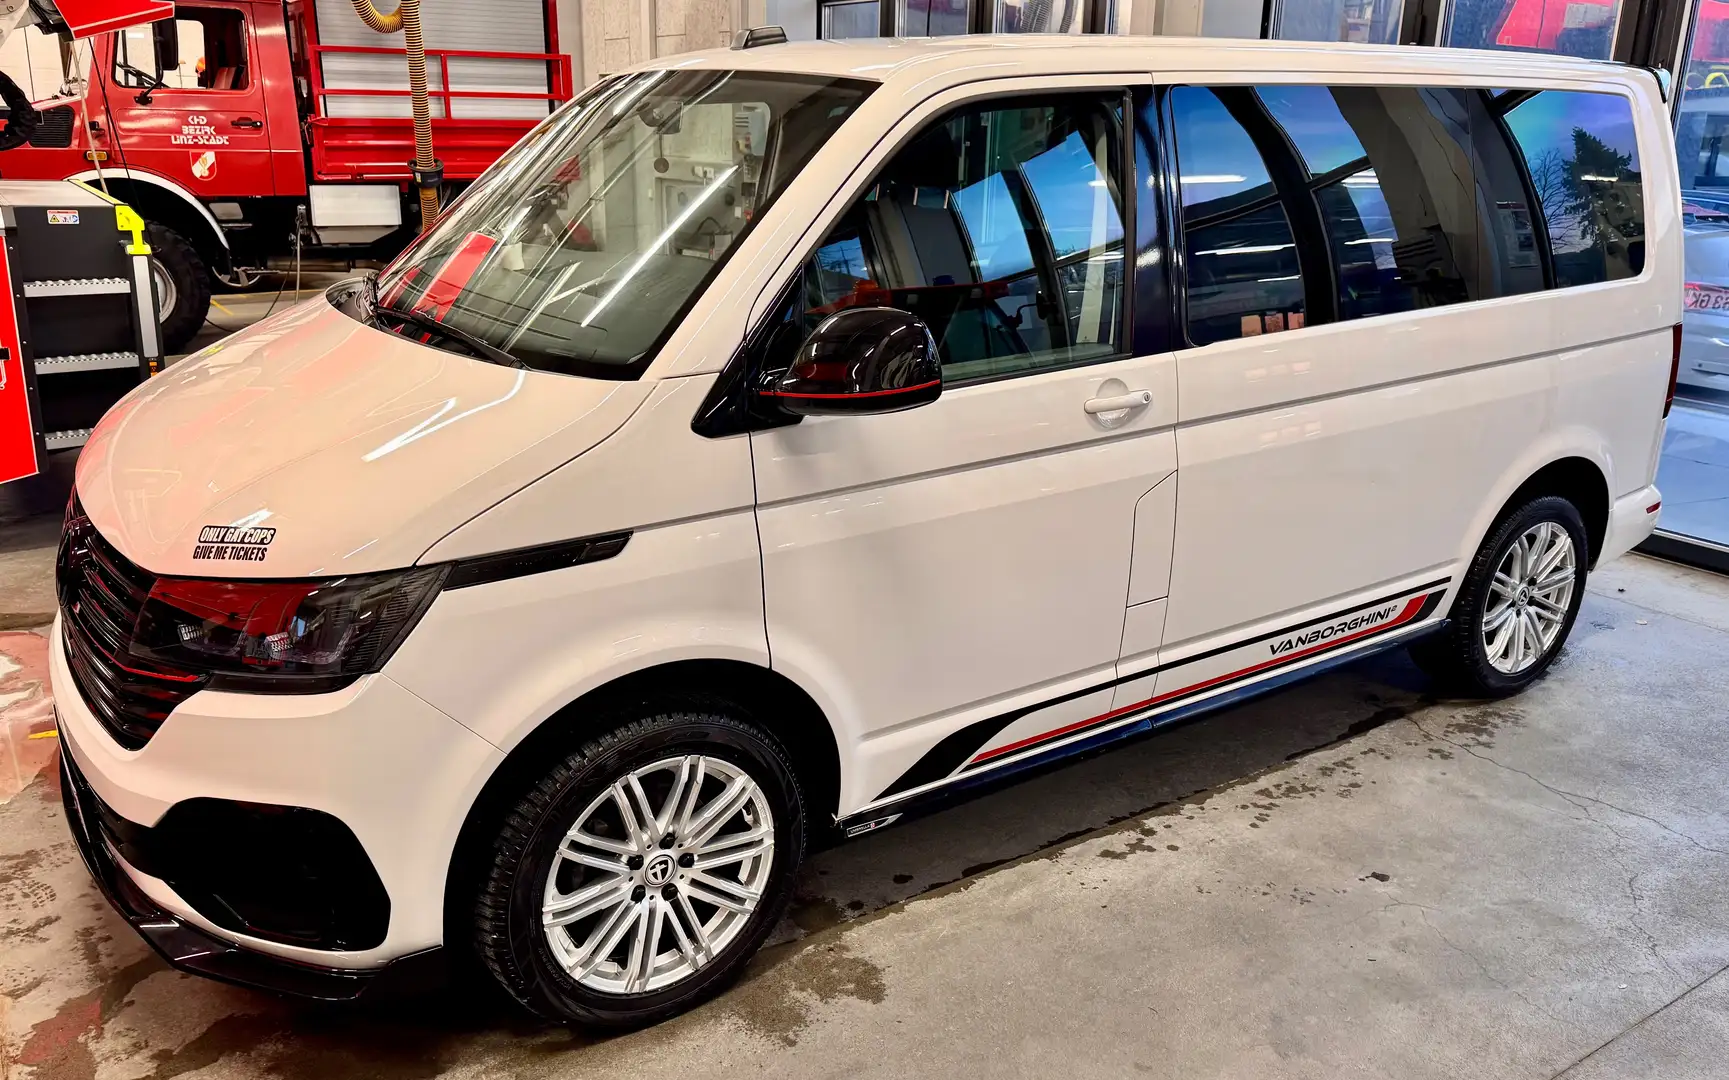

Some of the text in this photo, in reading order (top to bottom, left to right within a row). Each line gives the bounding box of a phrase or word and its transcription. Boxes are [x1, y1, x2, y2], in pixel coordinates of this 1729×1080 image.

[181, 126, 216, 135] BEZIRK
[200, 527, 275, 544] ONLY GAY COPS
[192, 545, 267, 562] GIVE ME TICKETS
